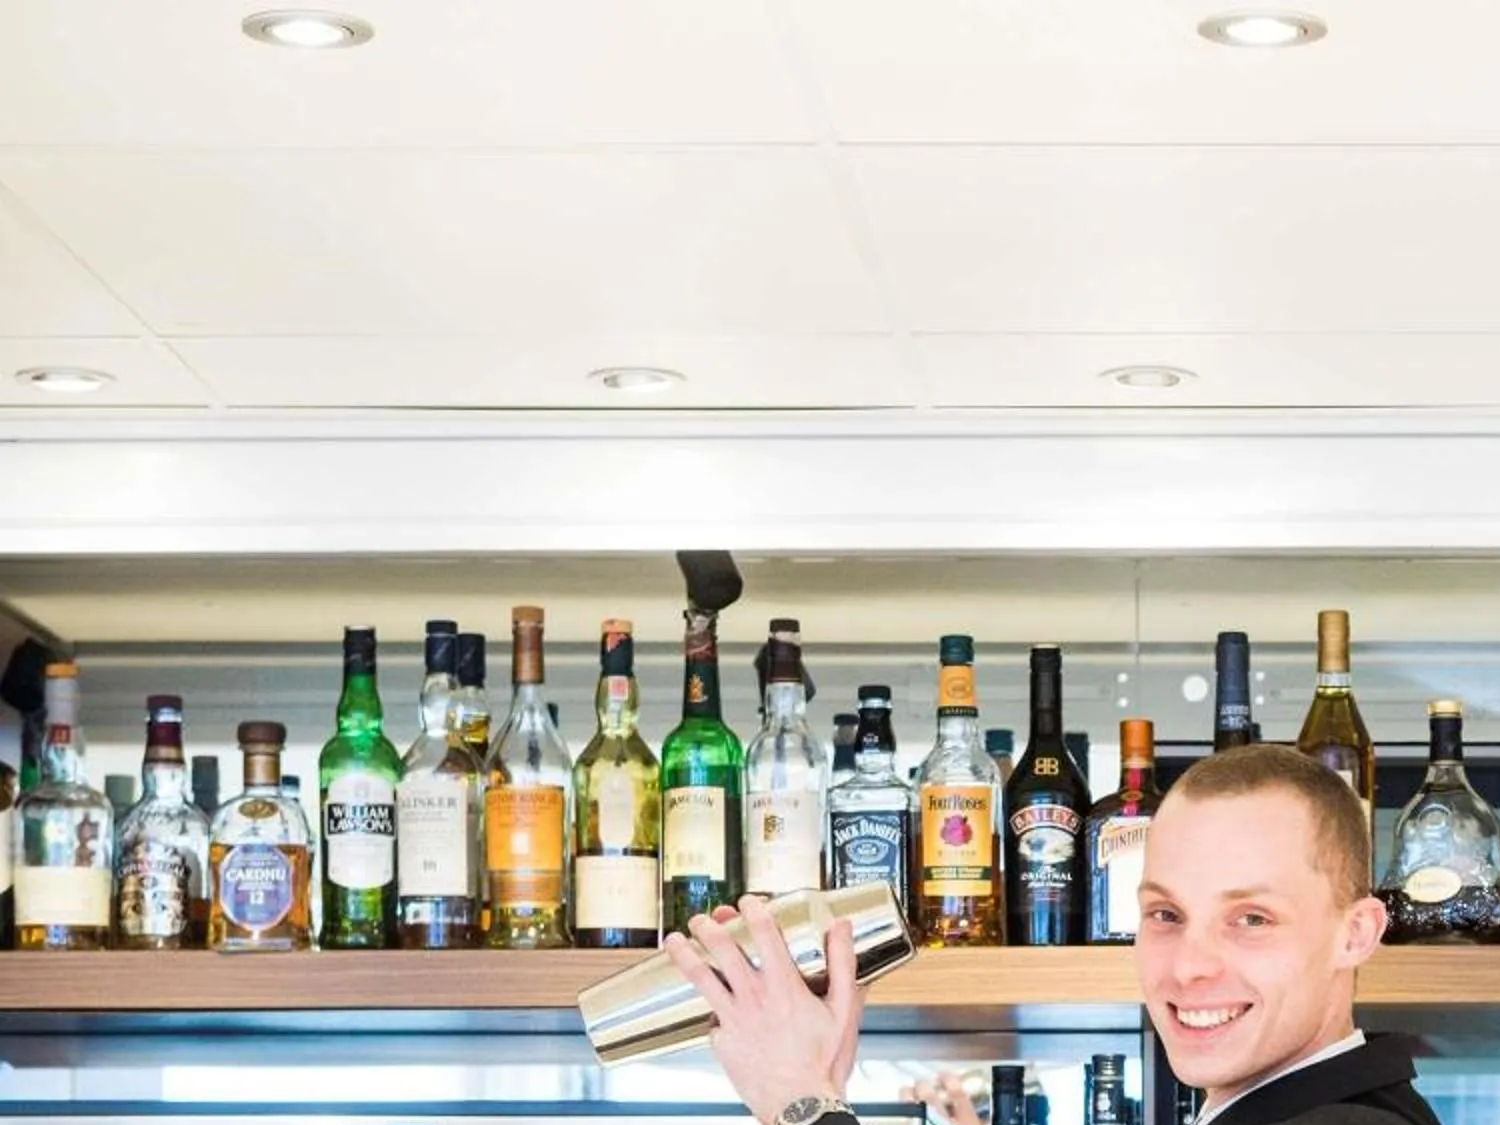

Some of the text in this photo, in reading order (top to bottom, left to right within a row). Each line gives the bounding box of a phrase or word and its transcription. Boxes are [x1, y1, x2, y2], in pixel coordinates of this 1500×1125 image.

[331, 805, 390, 819] WILLIAM
[1014, 806, 1079, 829] BAILEYS
[834, 826, 859, 847] JACK
[248, 890, 265, 906] 12
